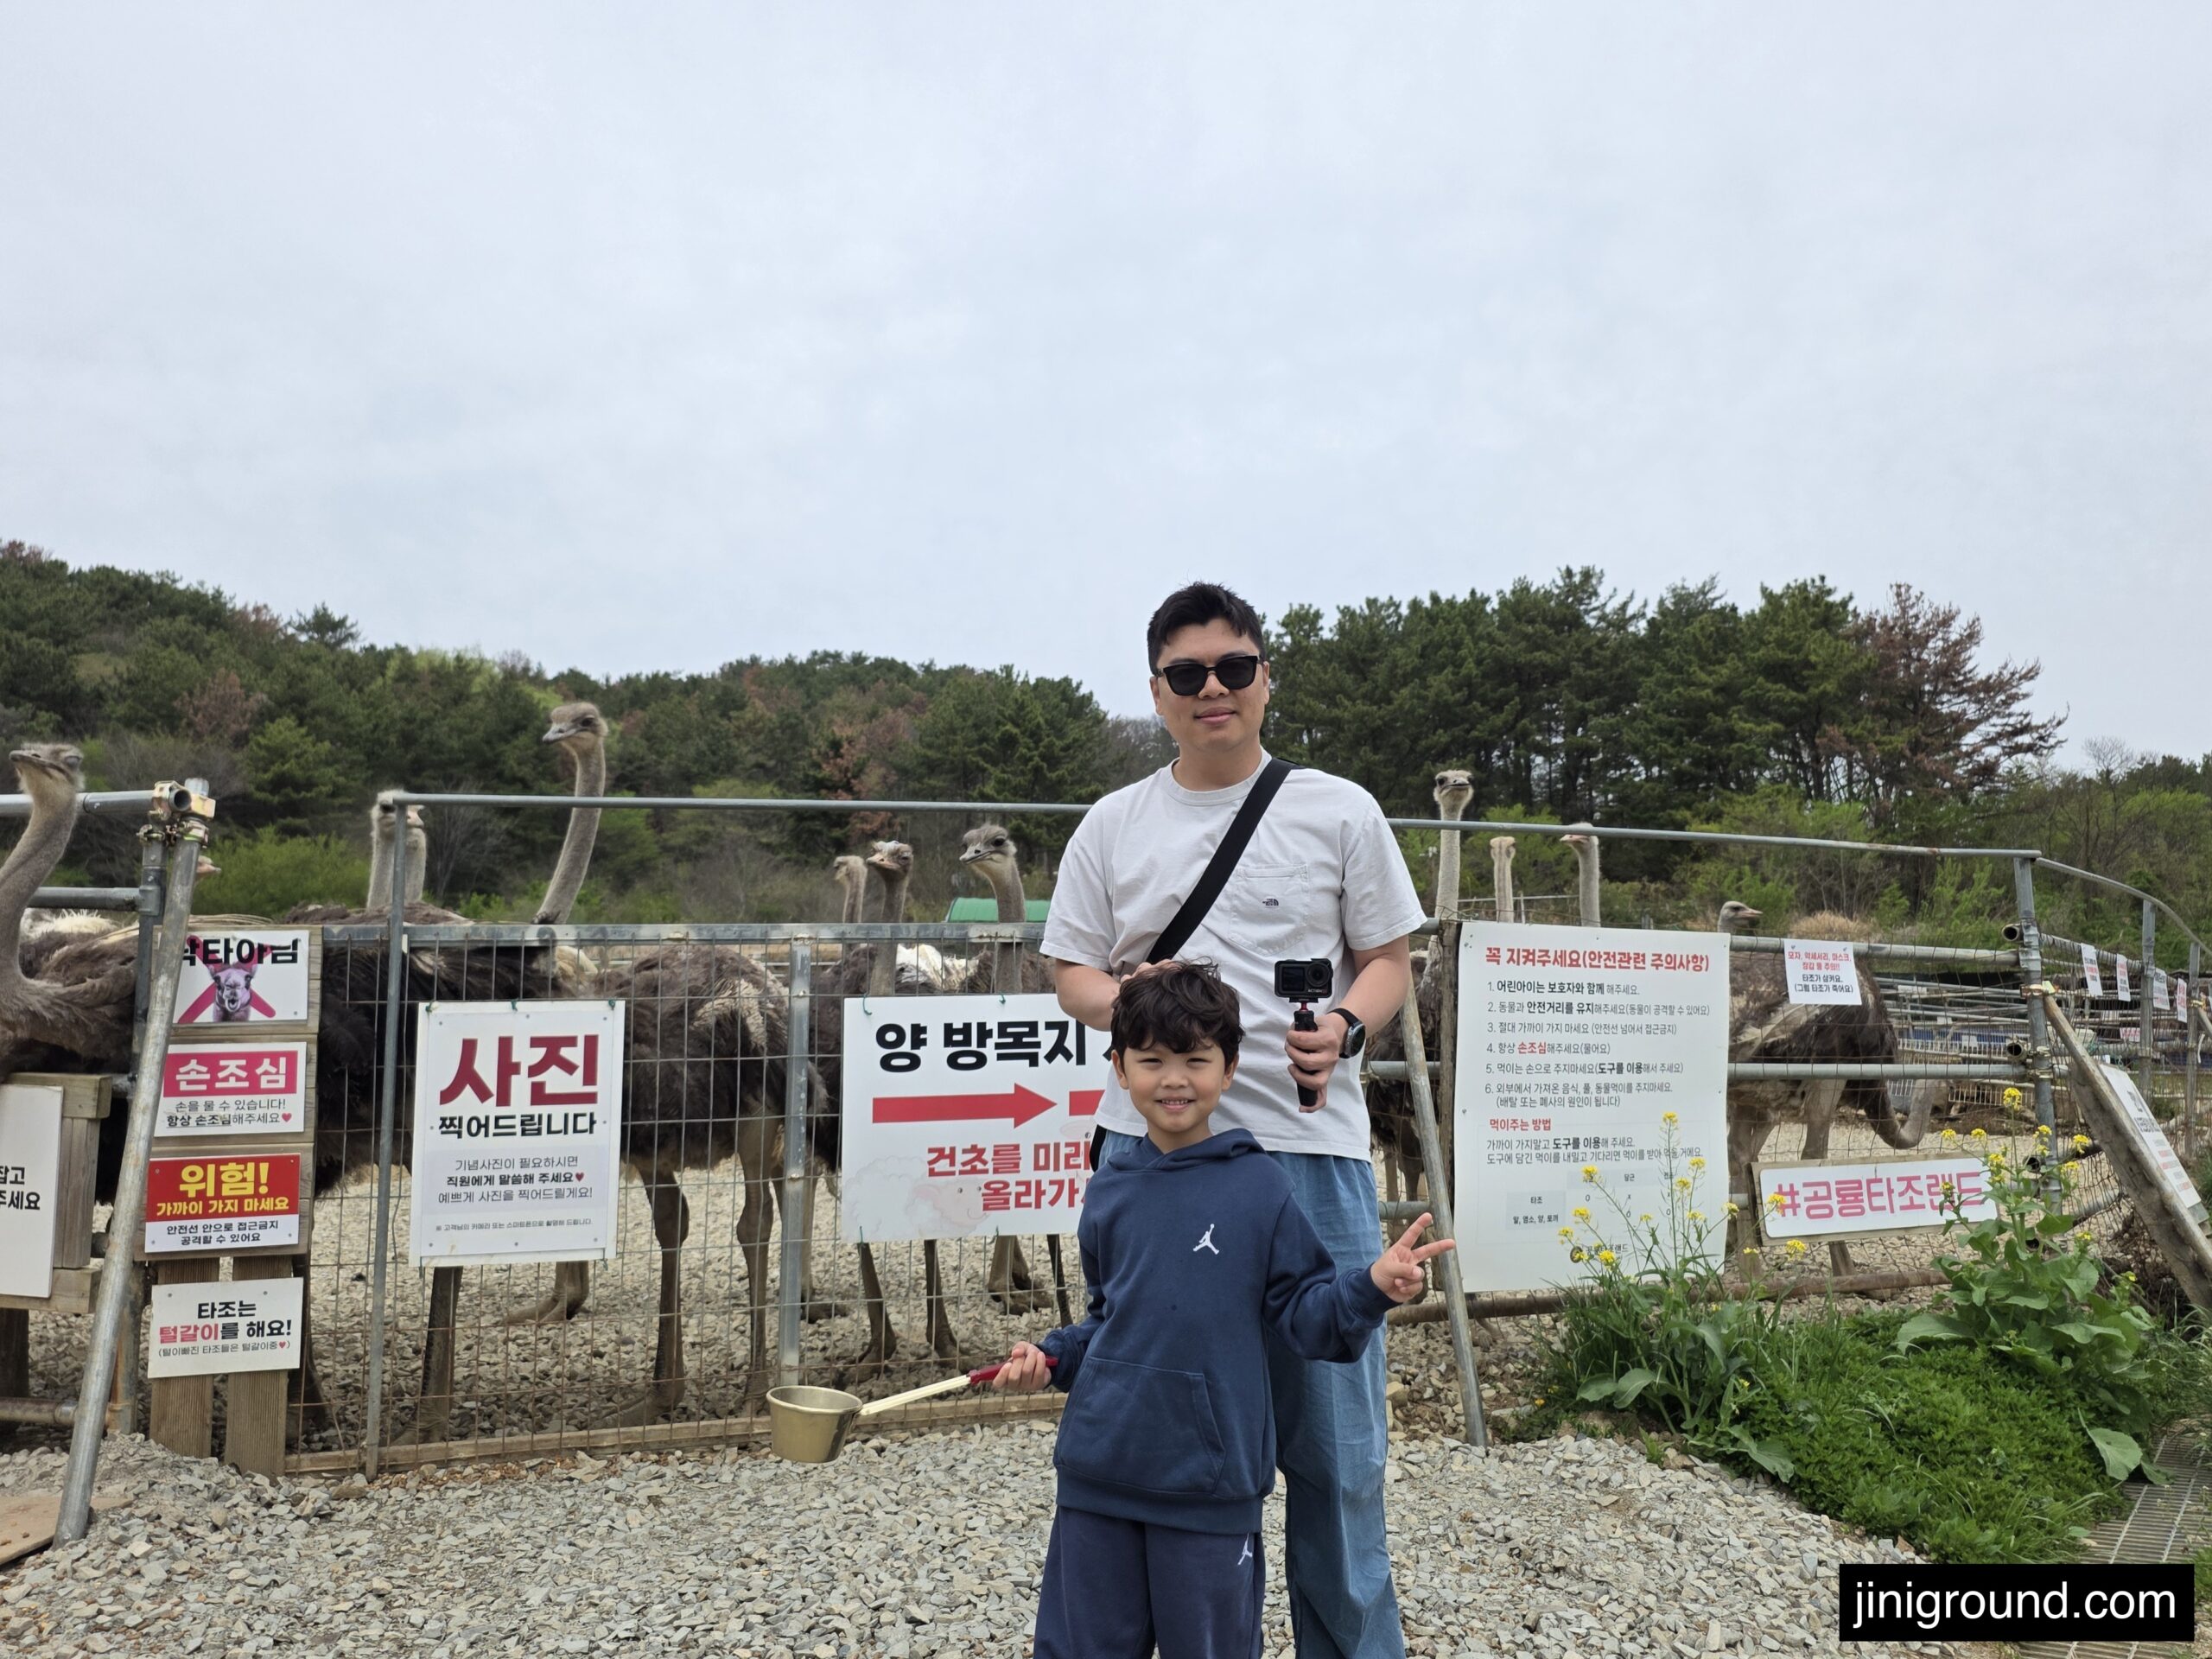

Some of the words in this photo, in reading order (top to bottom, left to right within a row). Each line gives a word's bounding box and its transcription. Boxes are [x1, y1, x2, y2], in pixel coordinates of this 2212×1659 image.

[1485, 947, 1501, 966] 꼭
[1506, 948, 1646, 970] 지켜주세요(안전관련
[1650, 953, 1709, 972] 주의사항)
[1802, 974, 1821, 982] 타조가
[1487, 982, 1495, 992] 1.
[1497, 980, 1546, 994] 어린아이는
[1548, 982, 1585, 995] 보호자와
[1586, 982, 1605, 995] 함께
[1606, 984, 1640, 995] 해주세요.
[1811, 984, 1830, 993] 타조가
[1487, 1002, 1497, 1013] 2.
[1498, 1001, 1524, 1014] 동물과
[1527, 1001, 1573, 1015] 안전거리를
[1576, 1002, 1651, 1016] 유지해주세요(동물이
[1653, 1005, 1675, 1016] 공격할
[1677, 1005, 1685, 1016] 수
[1686, 1004, 1710, 1016] 있어요)
[1487, 1022, 1497, 1033] 3.
[1498, 1021, 1516, 1033] 절대
[1518, 1021, 1544, 1034] 가까이
[1546, 1022, 1562, 1034] 가지
[1564, 1023, 1589, 1034] 마세요
[1591, 1023, 1618, 1035] (안전선
[1620, 1023, 1643, 1035] 넘어서
[1644, 1023, 1677, 1035] 접근금지)
[875, 1023, 928, 1072] 양
[943, 1020, 1086, 1071] 방목지
[1486, 1042, 1496, 1053] 4.
[1498, 1042, 1516, 1054] 항상
[1517, 1041, 1611, 1055] 손조심해주세요(물어요)
[175, 1057, 287, 1091] 손조심
[439, 1034, 600, 1107] 사진
[1485, 1063, 1494, 1074] 5.
[1497, 1063, 1524, 1075] 먹이는
[1525, 1063, 1552, 1075] 손으로
[1554, 1062, 1624, 1075] 주지마세요(도구를
[1626, 1062, 1657, 1074] 이용해서
[1659, 1062, 1684, 1074] 주세요)
[1484, 1083, 1494, 1094] 6.
[1496, 1083, 1532, 1095] 외부에서
[1534, 1083, 1560, 1095] 가져온
[1561, 1083, 1580, 1096] 음식,
[1595, 1082, 1633, 1094] 동물먹이를
[1635, 1082, 1673, 1093] 주지마세요.
[175, 1099, 200, 1113] 손을
[203, 1099, 214, 1112] 물
[218, 1100, 230, 1112] 수
[234, 1098, 286, 1111] 있습니다!
[1497, 1096, 1518, 1109] (배탈
[1520, 1096, 1537, 1108] 또는
[1539, 1096, 1565, 1108] 폐사의
[1567, 1096, 1592, 1108] 원인이
[1594, 1096, 1621, 1108] 됩니다)
[167, 1115, 191, 1127] 항상
[438, 1111, 597, 1139] 찍어드립니다
[1490, 1118, 1529, 1132] 먹이주는
[1531, 1118, 1552, 1132] 방법
[1487, 1139, 1513, 1151] 가까이
[1515, 1138, 1550, 1151] 가지말고
[1552, 1137, 1580, 1150] 도구를
[1583, 1136, 1609, 1149] 이용해
[1611, 1136, 1636, 1148] 주세요.
[455, 1158, 515, 1172] 기념사진이
[519, 1155, 578, 1169] 필요하시면
[927, 1143, 1021, 1177] 건초를
[1487, 1153, 1513, 1165] 도구에
[1515, 1152, 1533, 1165] 담긴
[1535, 1152, 1560, 1164] 먹이를
[1562, 1151, 1587, 1163] 내밀고
[1590, 1150, 1621, 1162] 기다리면
[1623, 1149, 1645, 1160] 먹이를
[1646, 1148, 1662, 1160] 받아
[179, 1162, 270, 1198] 위험!
[447, 1174, 495, 1187] 직원에게
[499, 1173, 535, 1186] 말씀해
[538, 1172, 574, 1184] 주세요
[438, 1191, 474, 1204] 예쁘게
[478, 1189, 514, 1202] 사진을
[518, 1186, 593, 1201] 찍어드릴게요!
[981, 1178, 1091, 1211] 올라가
[1530, 1196, 1543, 1205] 타조
[156, 1201, 203, 1217] 가까이
[208, 1199, 238, 1214] 가지
[244, 1197, 289, 1211] 마세요
[167, 1224, 199, 1235] 안전선
[202, 1222, 233, 1233] 안으로
[238, 1220, 279, 1231] 접근금지
[181, 1236, 213, 1246] 공격할
[216, 1235, 226, 1244] 수
[230, 1233, 261, 1243] 있어요
[197, 1300, 257, 1319] 타조는
[159, 1322, 239, 1344] 털갈이를
[246, 1319, 292, 1338] 해요!
[158, 1345, 200, 1357] (털이빠진
[202, 1344, 239, 1355] 타조들은
